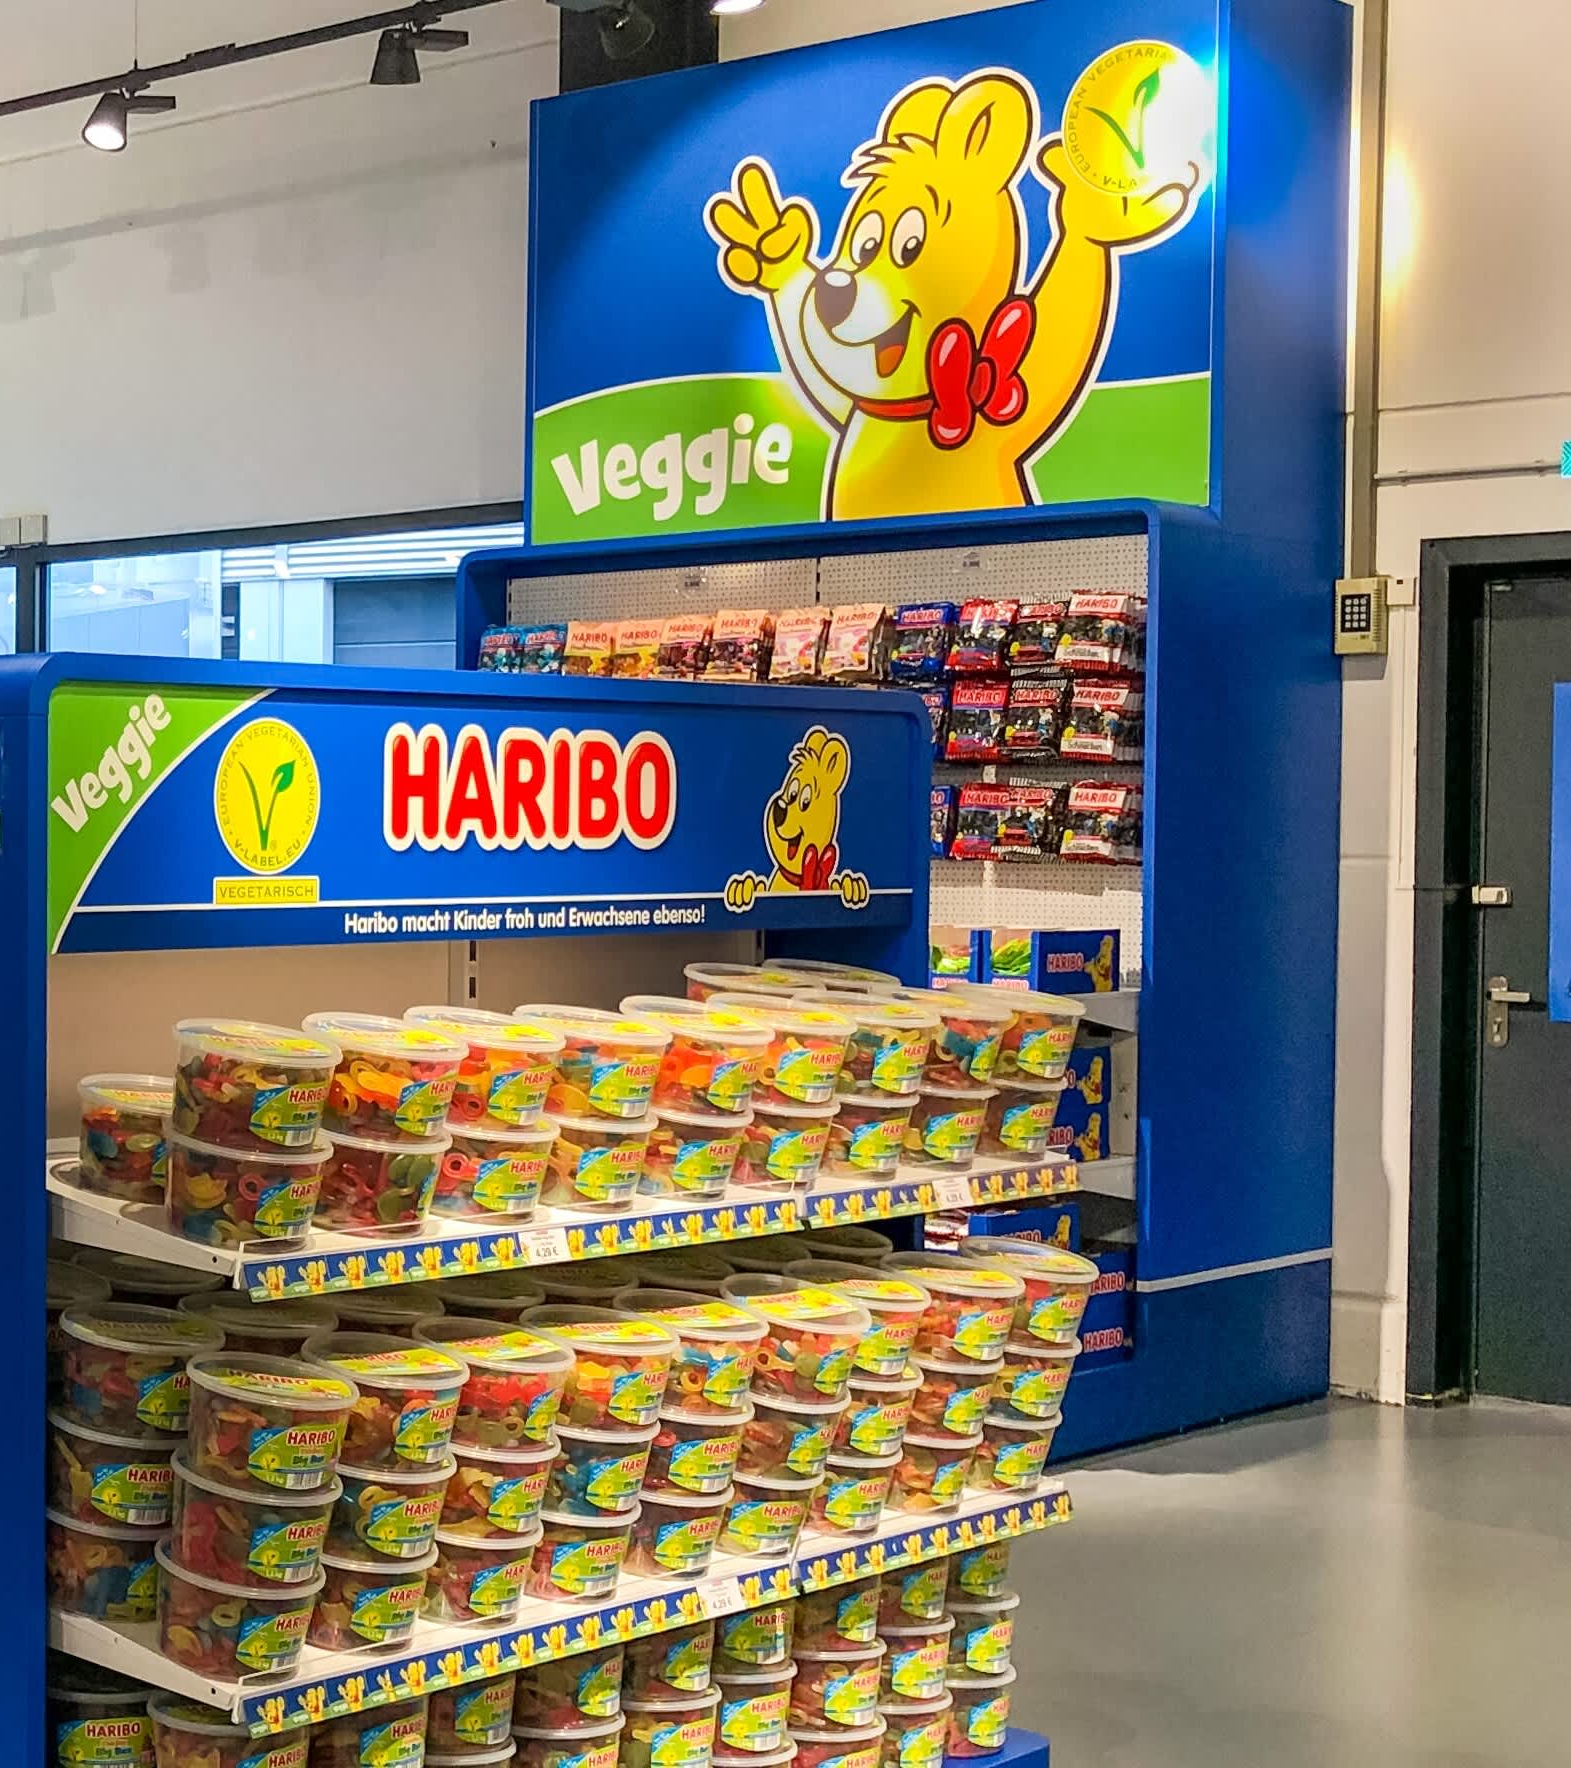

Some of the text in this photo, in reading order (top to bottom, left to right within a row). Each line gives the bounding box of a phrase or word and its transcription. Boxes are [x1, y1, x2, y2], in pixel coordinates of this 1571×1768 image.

[1068, 87, 1091, 173] EUROPEAN
[551, 412, 793, 521] Veggie
[1077, 597, 1117, 608] HARIBO
[721, 618, 757, 629] HARIBO
[837, 613, 875, 624] HARIBO
[901, 611, 944, 622] HARIBO
[572, 633, 607, 643] HARIBO
[621, 630, 658, 640] HARIBO
[958, 689, 1001, 702] HARIBO
[1078, 689, 1120, 701] HARIBO
[50, 694, 172, 834] Veggie
[220, 726, 316, 826] EUROPEAN VEGETARIAN UNION
[386, 724, 675, 849] HARIBO
[1075, 792, 1116, 802] HARIBO
[219, 885, 314, 898] VEGETARISCH
[344, 904, 706, 934] Haribo macht Kinder froh und Erwachsene ebenso!
[1047, 952, 1084, 972] HARIBO
[1048, 1126, 1074, 1146] RIBO
[1084, 1328, 1123, 1353] HARIBO
[229, 1369, 309, 1385] HARIBO
[287, 1430, 335, 1446] HARIBO
[128, 1468, 174, 1482] HARIB
[86, 1723, 141, 1738] HARIBO
